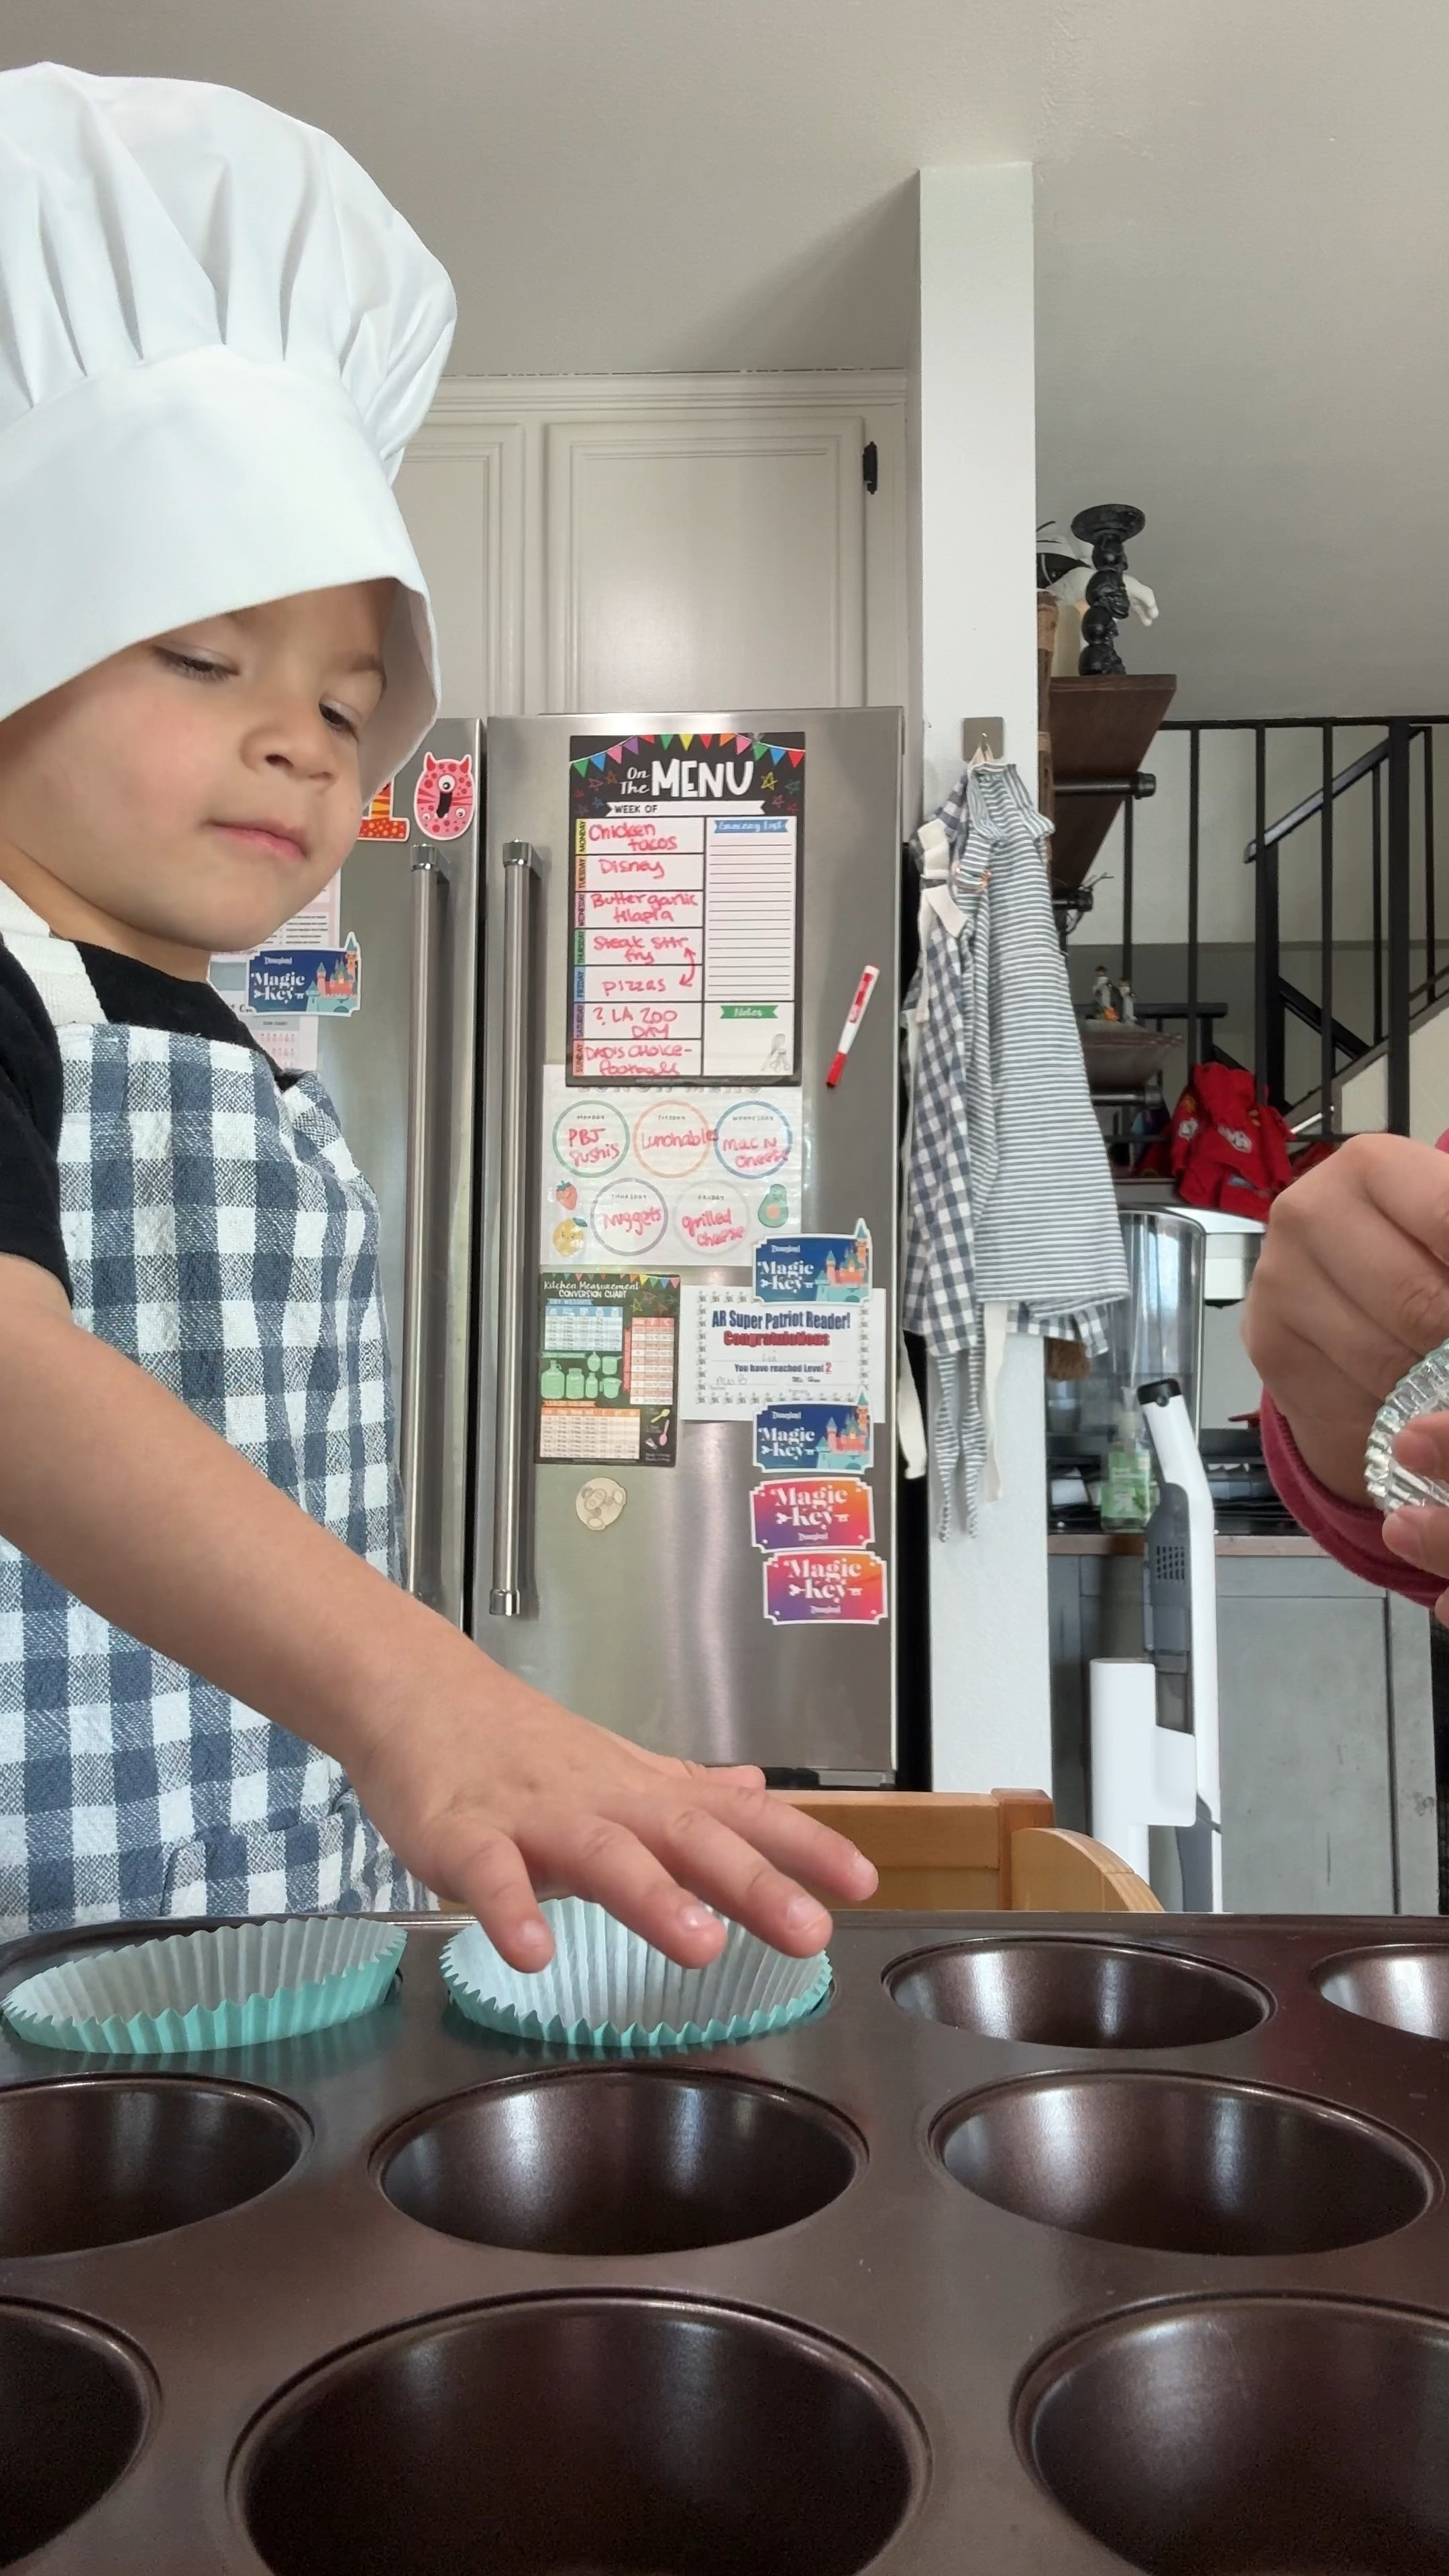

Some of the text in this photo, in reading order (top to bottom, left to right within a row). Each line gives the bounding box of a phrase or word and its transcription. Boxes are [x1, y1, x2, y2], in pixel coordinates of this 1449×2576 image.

[627, 767, 649, 780] On
[651, 758, 754, 798] MENU
[620, 782, 649, 794] The
[614, 805, 658, 814] WEEK OF
[578, 820, 586, 853] MONDAY
[589, 822, 656, 841] Chicken
[628, 836, 678, 851] tacos
[578, 859, 586, 889] TUESDAY
[598, 859, 665, 879] Disney
[590, 892, 647, 908] Butter
[251, 971, 305, 989] Magic
[577, 971, 585, 998] FRIDAY
[264, 986, 294, 1004] Key
[612, 1007, 633, 1022] LA
[569, 1128, 606, 1147] PBJ
[757, 1260, 814, 1278] Magic
[772, 1275, 803, 1293] Key
[559, 1290, 602, 1298] CONVERSION
[712, 1310, 851, 1330] AR Super Patriot Reader!
[723, 1330, 830, 1348] Congratulations
[735, 1364, 749, 1372] You
[750, 1364, 769, 1372] have
[770, 1363, 802, 1373] reached
[758, 1427, 815, 1445] Magic
[773, 1442, 804, 1460] Key
[770, 1485, 848, 1509] Magic
[792, 1506, 835, 1530] Key
[784, 1558, 862, 1582] Magic
[806, 1578, 847, 1603] Key
